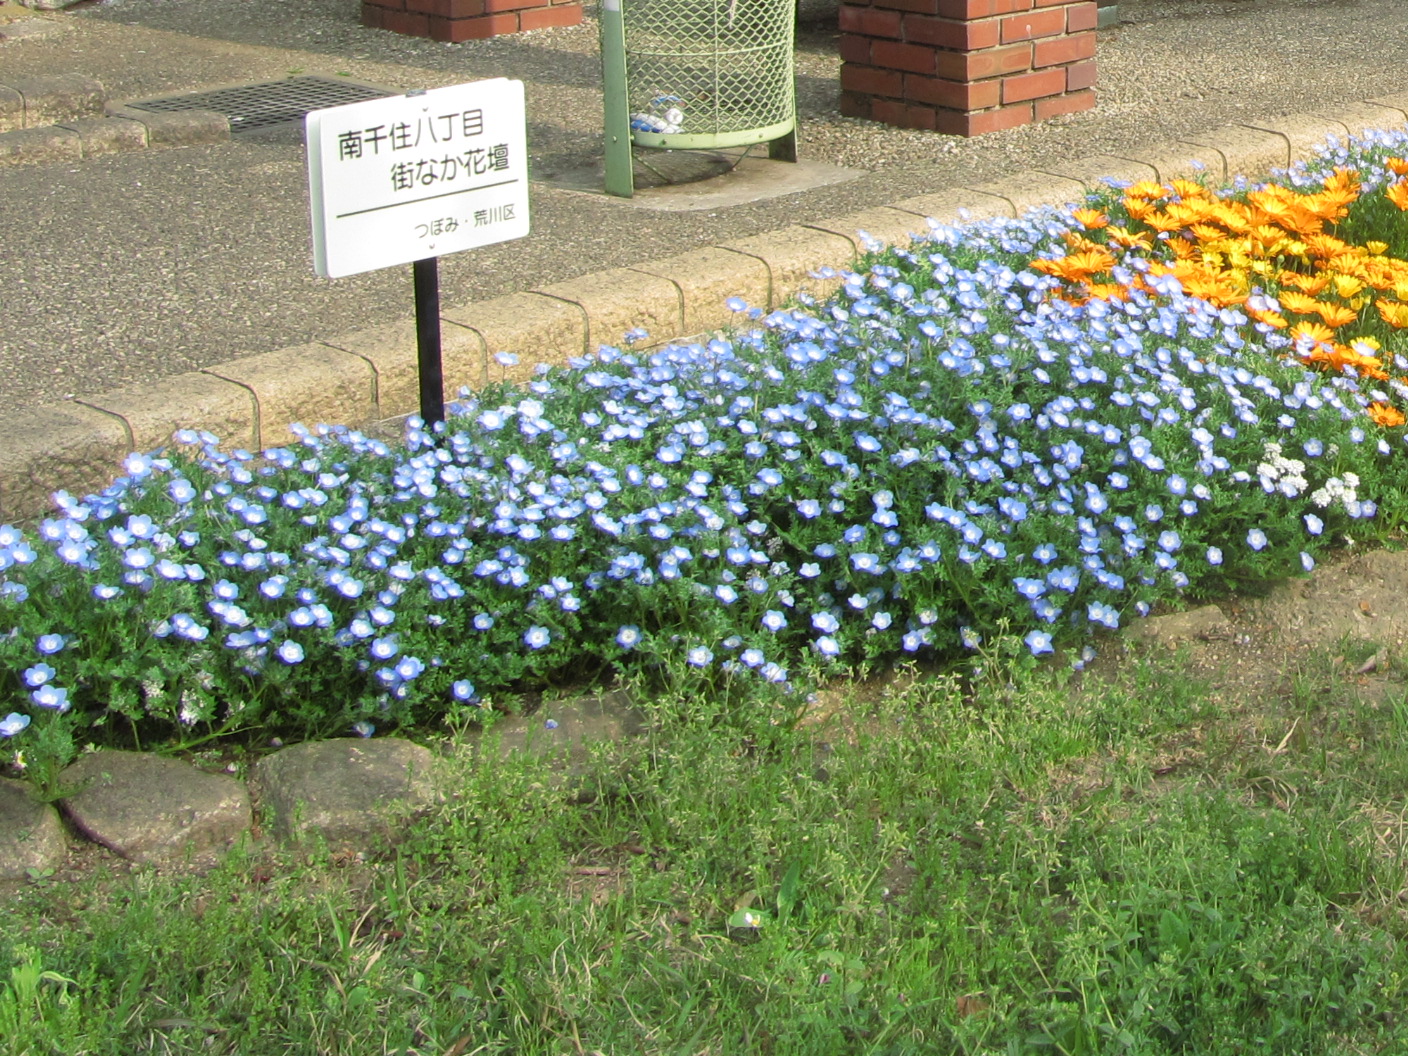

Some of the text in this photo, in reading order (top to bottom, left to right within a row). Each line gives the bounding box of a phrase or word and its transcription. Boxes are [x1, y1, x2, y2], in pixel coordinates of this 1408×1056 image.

[338, 108, 484, 161] 南千住八丁目
[390, 143, 510, 192] 街なか花壇
